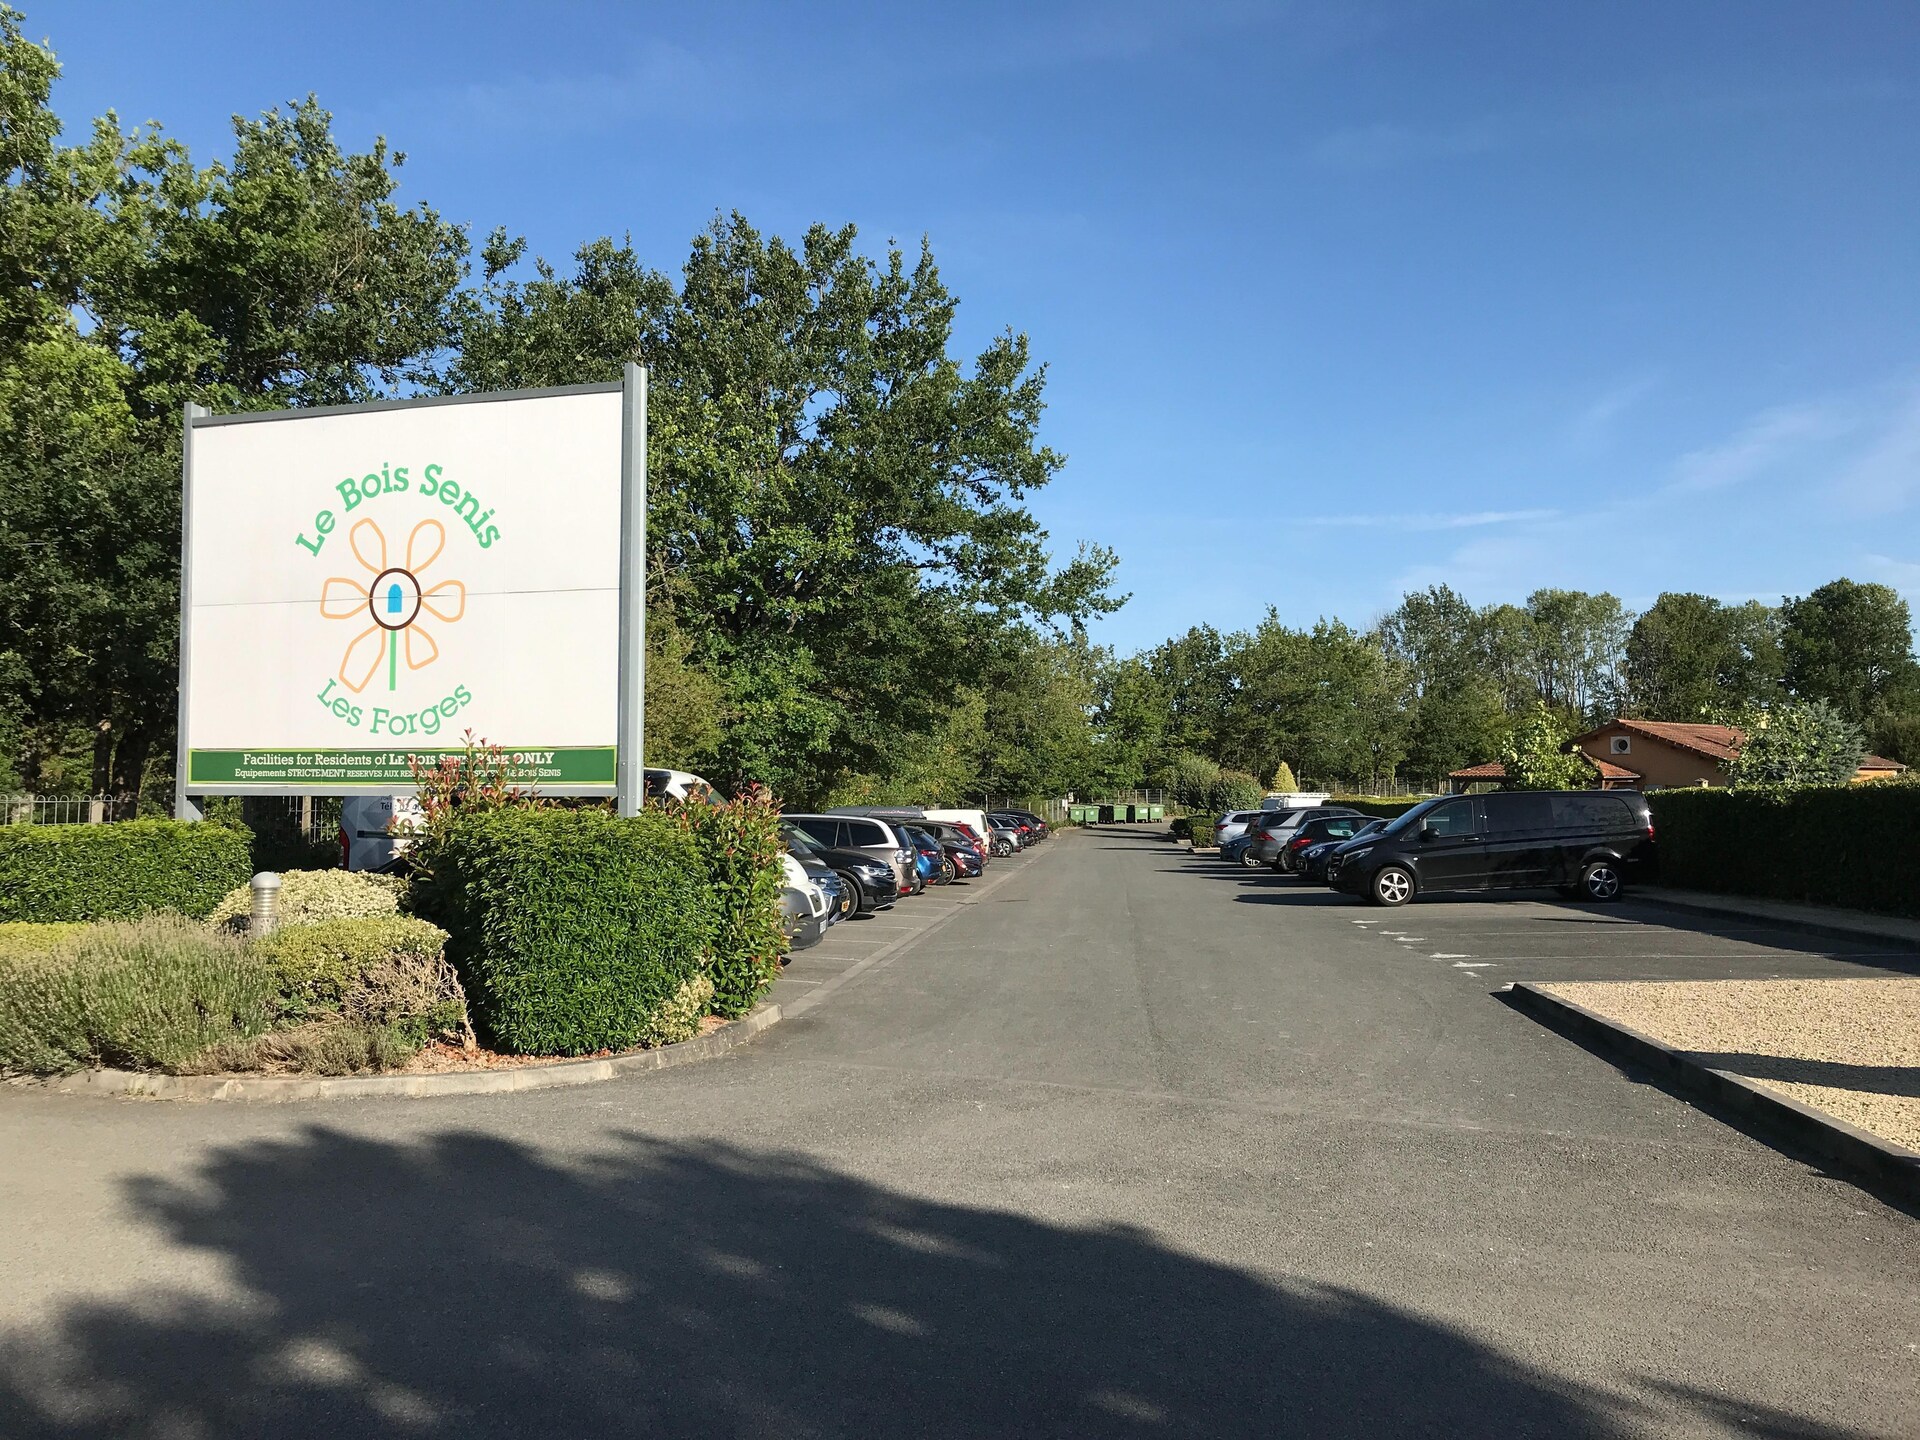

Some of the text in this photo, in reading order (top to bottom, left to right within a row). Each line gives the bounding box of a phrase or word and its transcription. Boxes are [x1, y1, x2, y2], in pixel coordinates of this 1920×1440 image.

[295, 462, 502, 556] Le Bois Senis
[316, 678, 473, 736] Les Forges
[243, 753, 294, 765] Facilities
[296, 753, 313, 765] for
[314, 753, 372, 765] Residents
[374, 753, 388, 765] of
[438, 753, 472, 765] SENI
[512, 752, 555, 765] ONLY
[234, 768, 287, 780] Equipements
[287, 768, 346, 778] STRICTEMENT
[383, 769, 399, 778] AUX
[538, 767, 562, 777] SENIS
[380, 801, 392, 811] Tél
